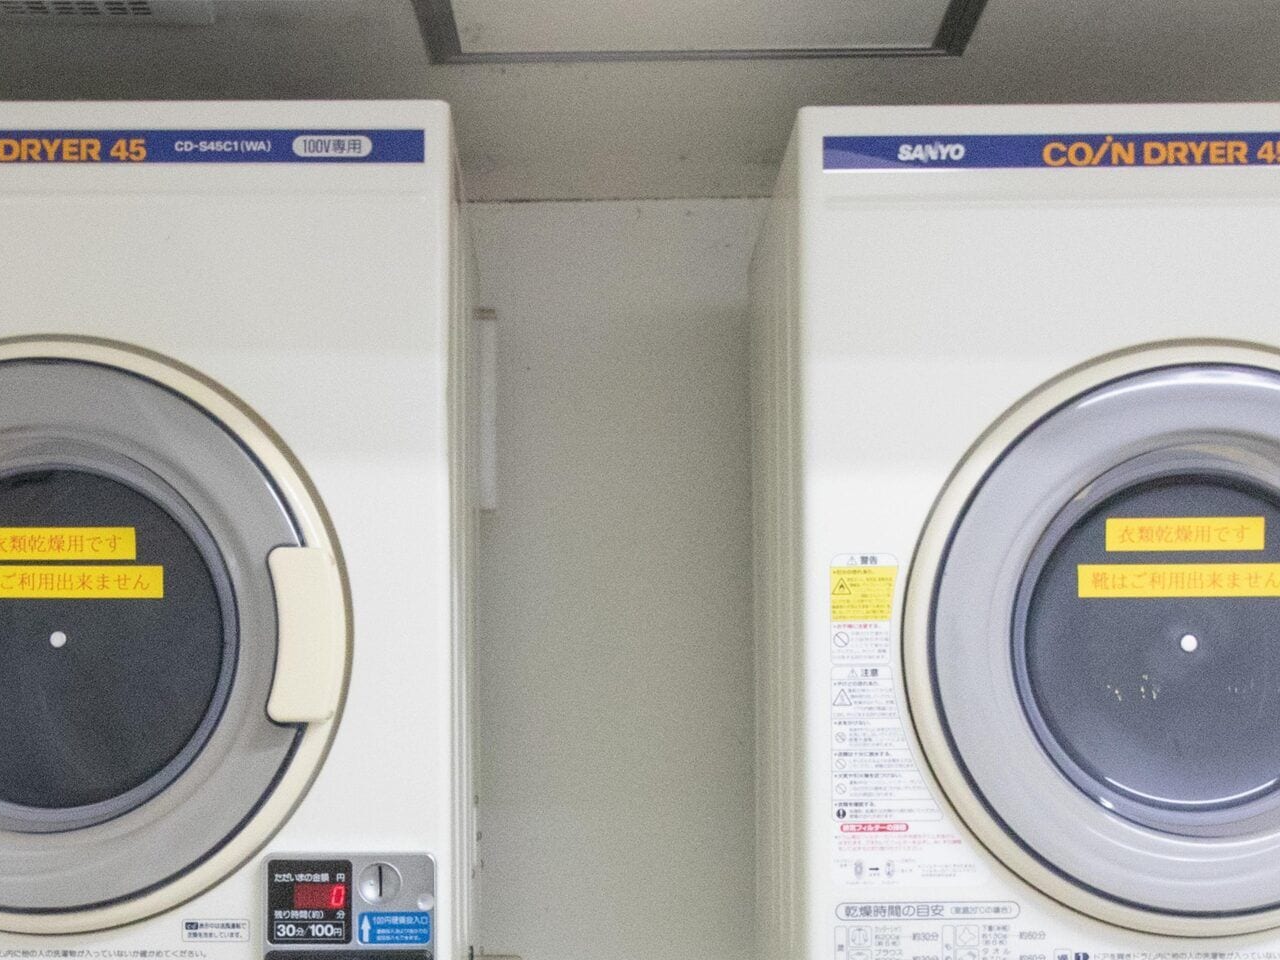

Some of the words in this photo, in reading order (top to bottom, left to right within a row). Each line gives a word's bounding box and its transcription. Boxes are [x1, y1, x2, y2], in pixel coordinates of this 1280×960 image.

[109, 139, 148, 161] 45
[174, 139, 273, 154] CD-S45C1(WA)
[300, 137, 364, 156] 100V専用
[897, 144, 965, 162] SANYO
[1143, 142, 1249, 165] DRYER
[1119, 525, 1251, 544] 衣類乾燥用です
[1092, 571, 1280, 590] 靴はご利用出来ません
[336, 873, 346, 882] 円
[331, 885, 346, 906] 0
[336, 910, 346, 920] 分
[844, 905, 945, 918] 乾燥時間の目安
[276, 924, 343, 937] 30分/100円
